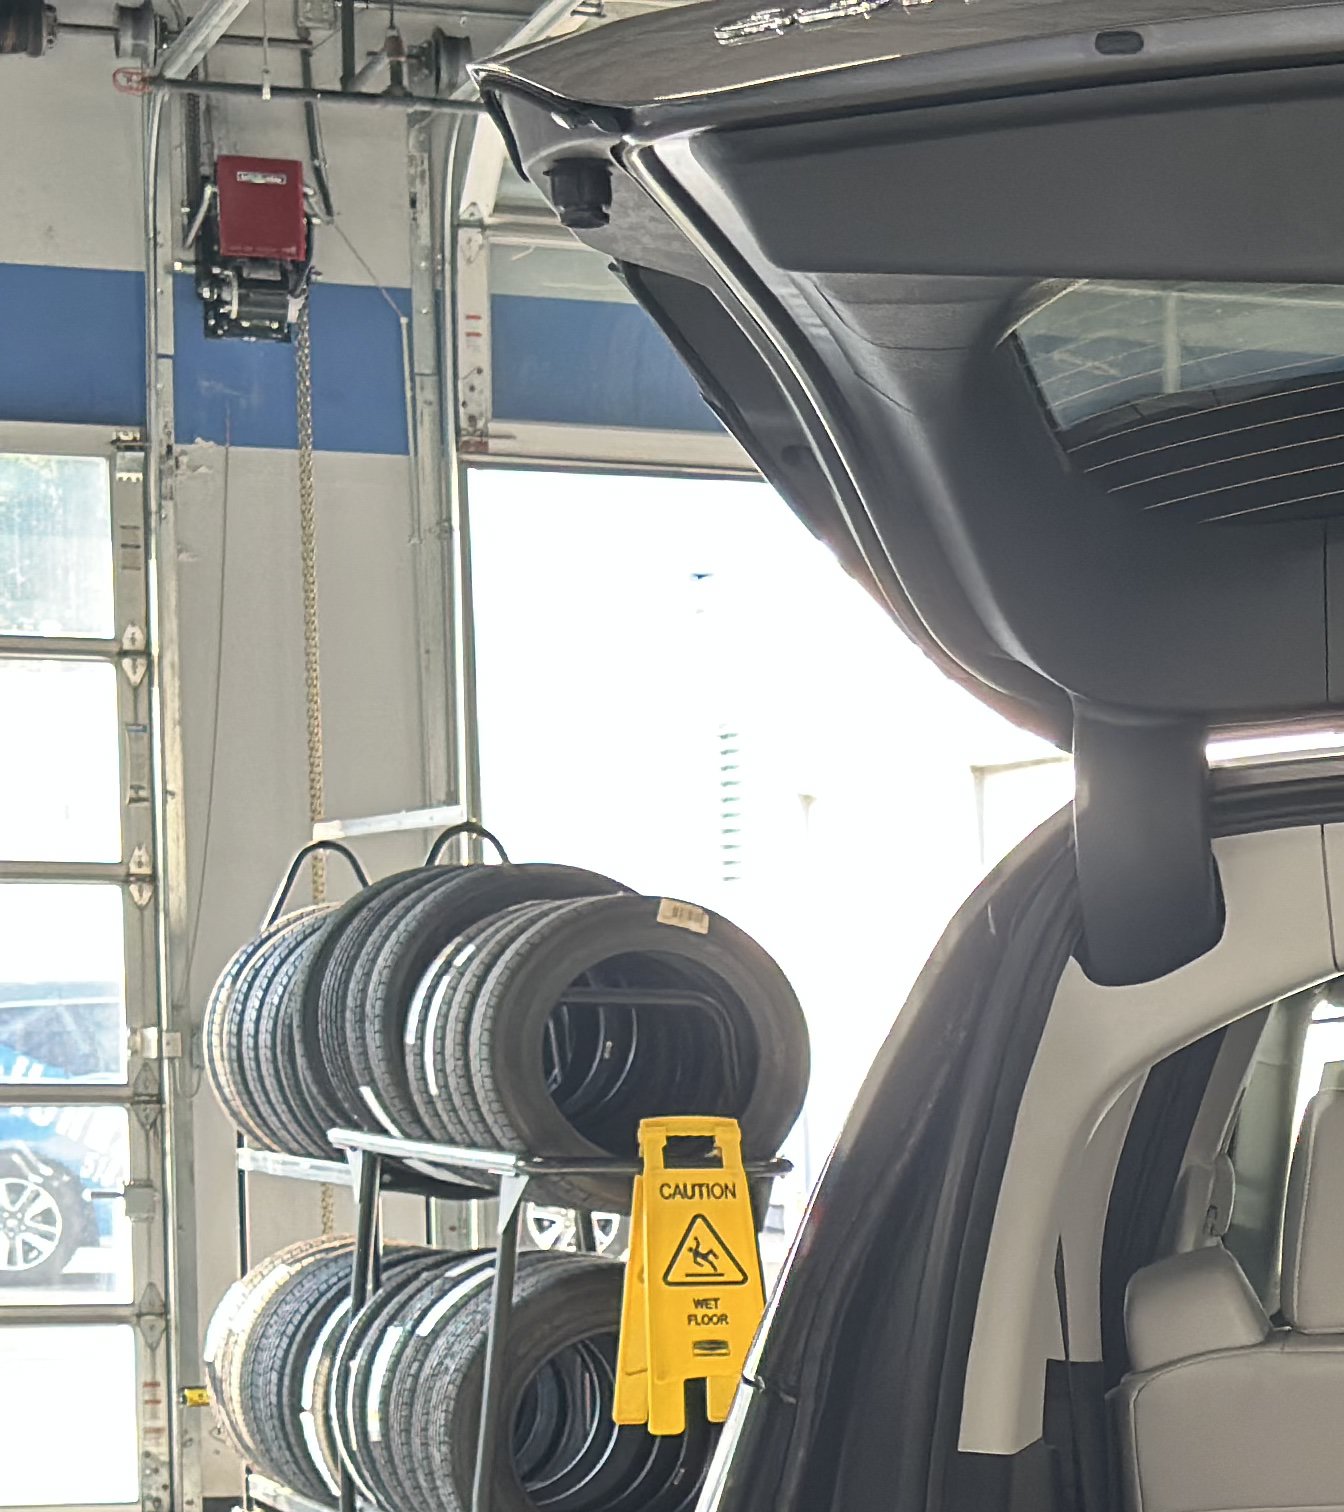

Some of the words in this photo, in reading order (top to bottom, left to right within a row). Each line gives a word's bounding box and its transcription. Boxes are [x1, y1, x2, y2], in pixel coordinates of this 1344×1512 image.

[659, 1182, 737, 1200] CAUTION
[693, 1298, 720, 1310] WET
[687, 1313, 729, 1326] FLOOR
